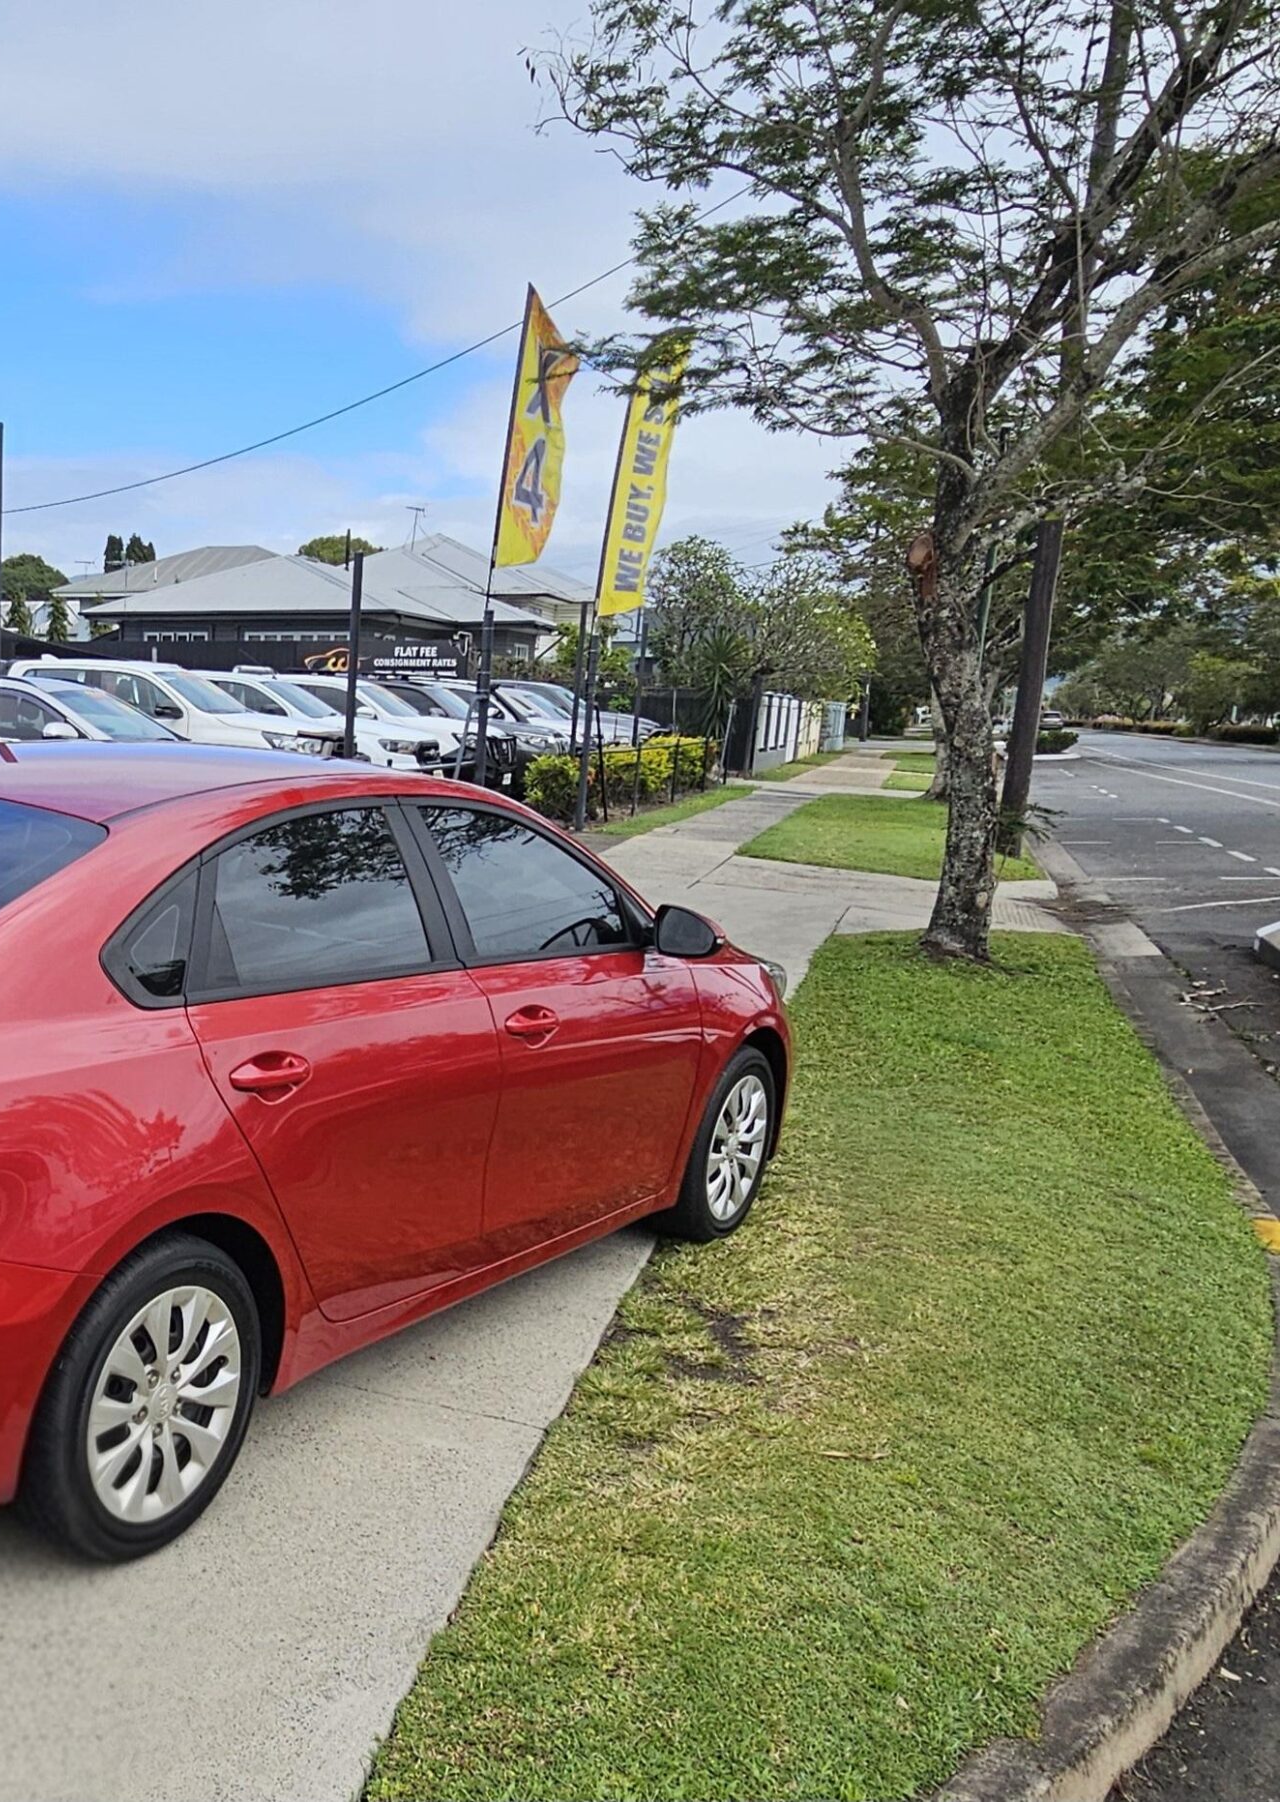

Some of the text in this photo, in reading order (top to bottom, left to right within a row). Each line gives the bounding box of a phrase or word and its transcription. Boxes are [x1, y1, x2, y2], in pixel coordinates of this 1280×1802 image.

[615, 549, 644, 593] WE
[632, 429, 661, 475] WE
[394, 646, 438, 657] FLAT FEE
[373, 659, 457, 667] CONSIGNMENT RATES
